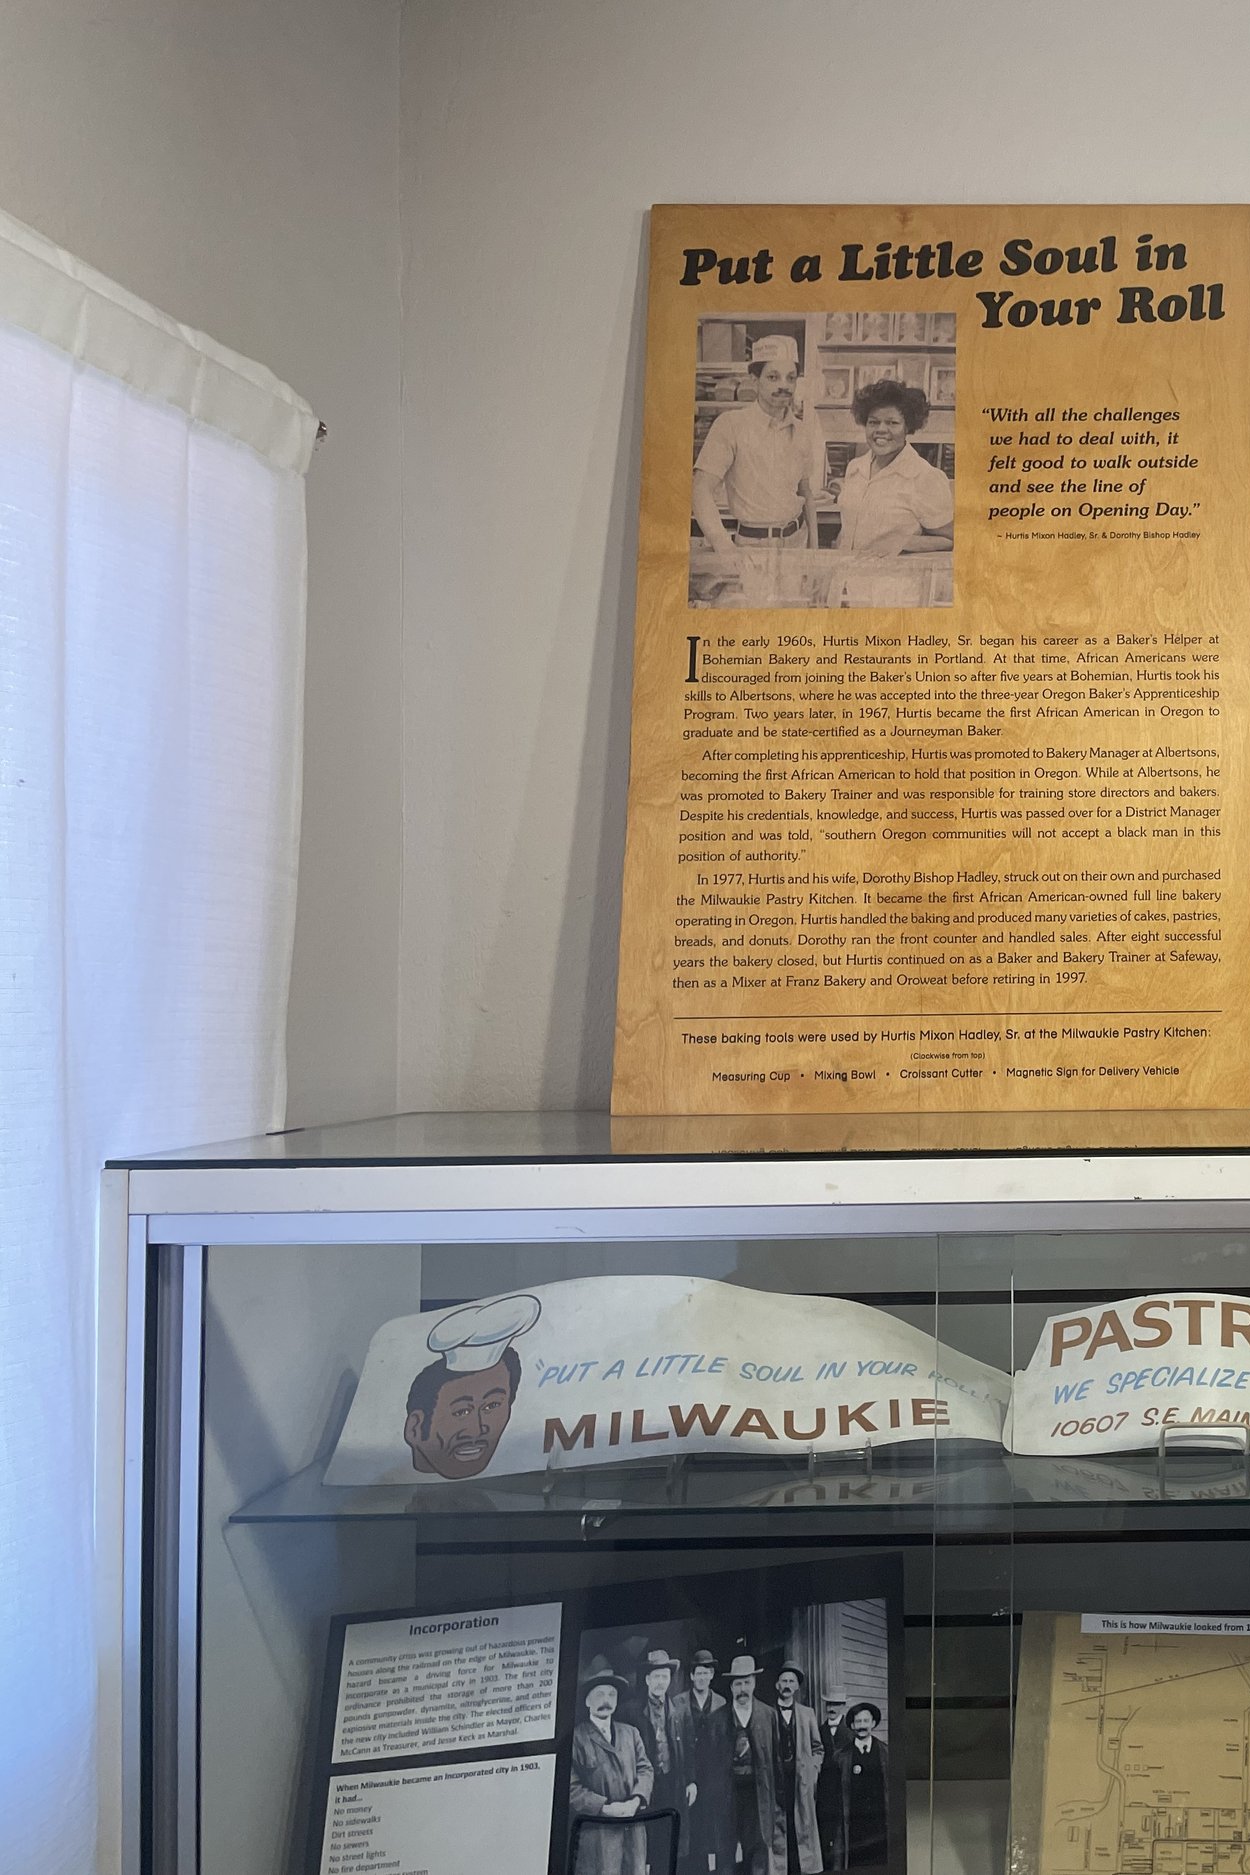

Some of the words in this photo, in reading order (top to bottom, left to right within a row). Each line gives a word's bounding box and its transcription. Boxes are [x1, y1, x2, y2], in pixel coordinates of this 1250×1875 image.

[679, 248, 773, 286] Put
[790, 255, 822, 283] a
[838, 241, 984, 281] Little
[999, 236, 1117, 277] Soul
[1136, 234, 1187, 271] in
[976, 291, 1101, 328] Your
[1117, 283, 1225, 323] Roll
[982, 407, 1028, 422] “With
[1034, 407, 1055, 421] all
[1061, 407, 1087, 421] the
[1093, 407, 1180, 424] challenges
[990, 435, 1012, 445] we
[1018, 431, 1050, 445] had
[1056, 433, 1072, 445] to
[1078, 431, 1114, 445] deal
[1120, 430, 1159, 447] with,
[1167, 431, 1179, 444] it
[987, 455, 1016, 472] felt
[1021, 454, 1064, 472] good
[1070, 456, 1086, 469] to
[1093, 454, 1132, 468] walk
[1137, 454, 1198, 468] outside
[989, 478, 1021, 493] and
[1026, 483, 1054, 493] see
[1060, 478, 1086, 492] the
[1093, 478, 1123, 492] line
[1128, 478, 1147, 495] of
[987, 502, 1045, 520] people
[1050, 507, 1071, 516] on
[1078, 502, 1149, 520] Opening
[1155, 502, 1200, 519] Day.”
[717, 635, 735, 647] the
[741, 635, 769, 649] early
[777, 635, 815, 647] 1960s,
[823, 635, 858, 646] Hurtis
[865, 635, 901, 646] Mixon
[907, 634, 950, 648] Hadley,
[957, 634, 972, 646] Sr.
[979, 634, 1014, 648] began
[1021, 634, 1037, 645] his
[1043, 637, 1078, 645] career
[1084, 637, 1097, 645] as
[1103, 637, 1110, 645] a
[1116, 633, 1157, 645] Baker’s
[1164, 633, 1202, 647] Helper
[1208, 634, 1219, 644] at
[681, 1033, 717, 1044] These
[721, 1032, 760, 1045] baking
[765, 1032, 793, 1043] tools
[797, 1033, 826, 1042] were
[830, 1031, 859, 1042] used
[863, 1030, 877, 1044] by
[881, 1030, 915, 1041] Hurtis
[919, 1029, 954, 1040] Mixon
[959, 1029, 1001, 1042] Hadley,
[1005, 1028, 1020, 1039] Sr.
[1024, 1028, 1035, 1039] at
[1039, 1028, 1057, 1039] the
[1061, 1027, 1119, 1038] Milwaukie
[1123, 1027, 1160, 1040] Pastry
[1163, 1026, 1210, 1037] Kitchen:
[910, 1052, 950, 1060] (Clockwise
[951, 1051, 969, 1059] from
[602, 1359, 625, 1380] A
[637, 1353, 729, 1376] LITTLE
[739, 1362, 804, 1383] SOUL
[816, 1361, 847, 1380] IN
[857, 1360, 918, 1378] YOUR
[1053, 1379, 1094, 1405] WE
[543, 1398, 951, 1454] MILWAUKIE
[1050, 1411, 1130, 1437] 10607
[1141, 1407, 1180, 1426] S.E.
[409, 1615, 499, 1636] Incorporation
[1101, 1619, 1119, 1629] This
[1120, 1619, 1127, 1629] is
[1128, 1620, 1147, 1630] how
[1148, 1620, 1192, 1630] Milwaukie
[1193, 1621, 1223, 1631] looked
[1224, 1622, 1245, 1632] from
